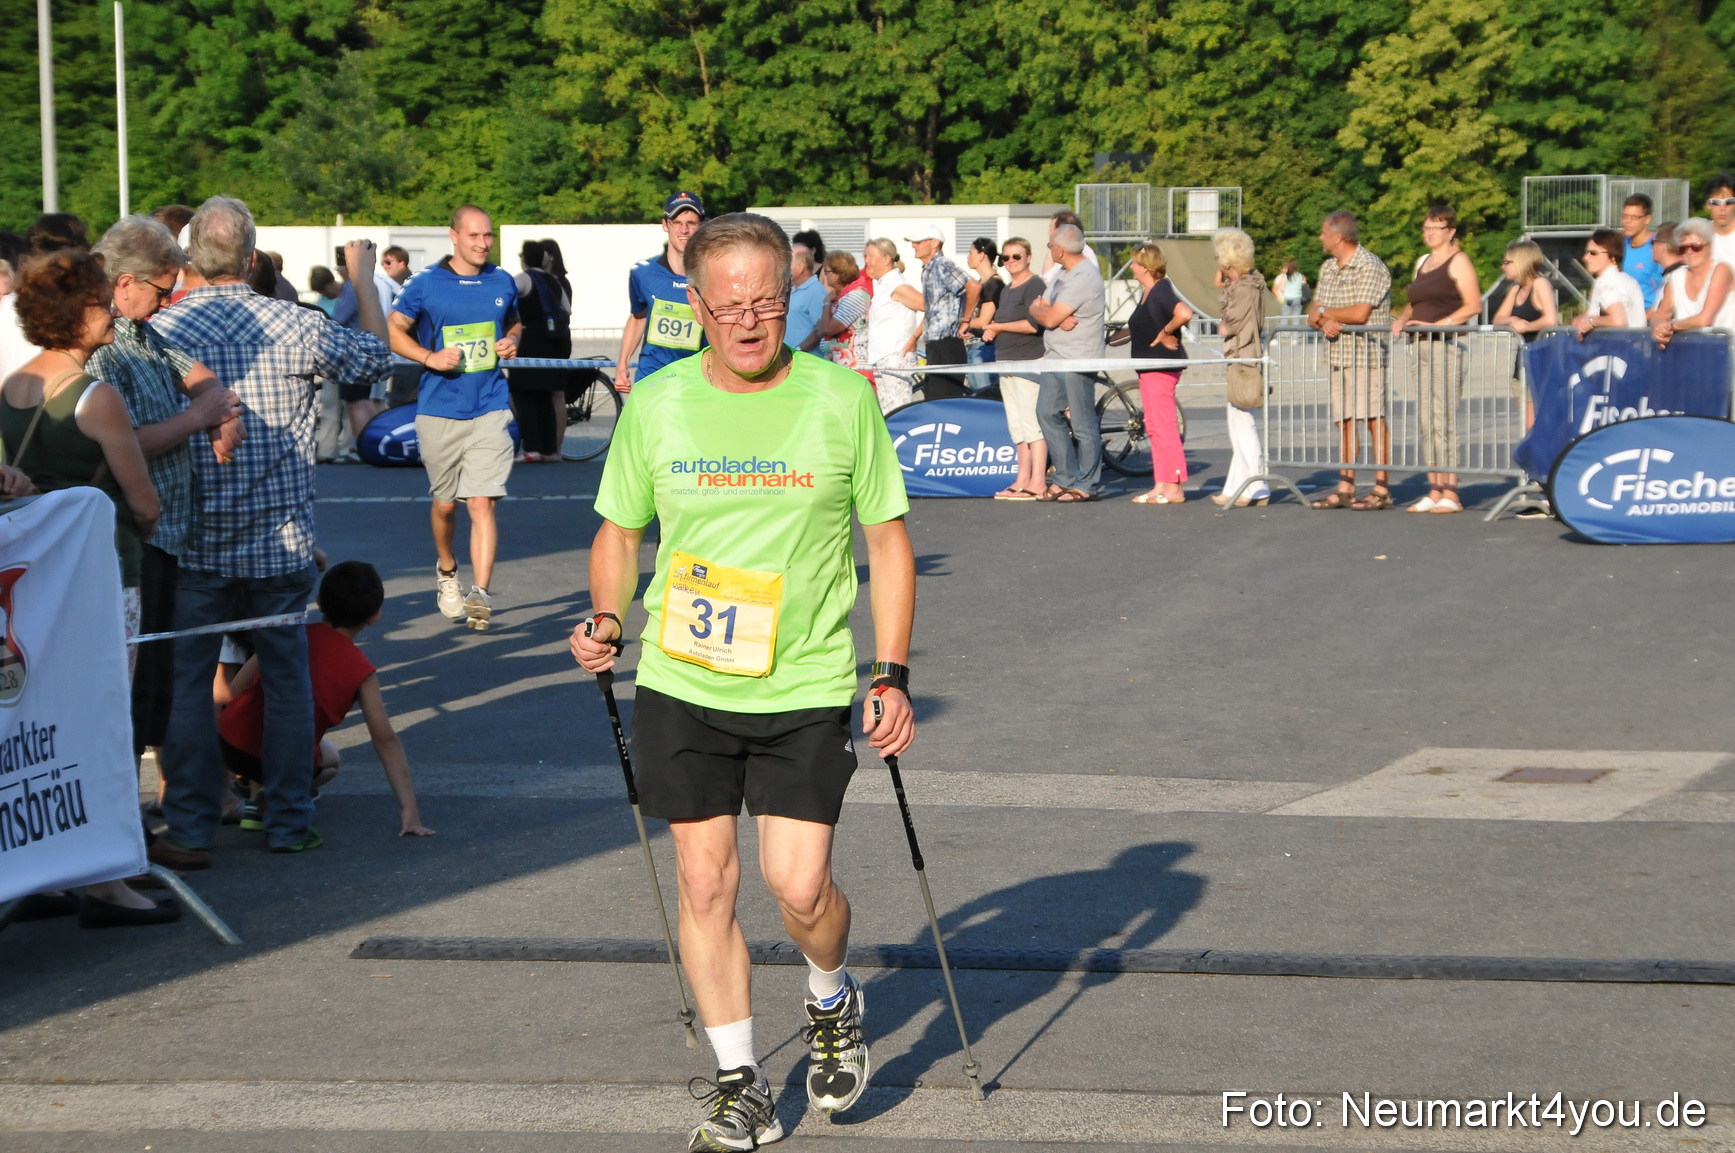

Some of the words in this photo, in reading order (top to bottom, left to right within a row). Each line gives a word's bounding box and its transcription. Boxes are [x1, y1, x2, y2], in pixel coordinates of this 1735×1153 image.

[657, 317, 693, 338] 691
[1579, 394, 1685, 435] Fisch
[914, 441, 1018, 466] Fische
[671, 456, 787, 474] autoladen
[925, 465, 1019, 477] AUTOMOBILE
[697, 470, 815, 488] neumarkt
[723, 487, 738, 496] und
[688, 598, 738, 645] 31
[688, 648, 715, 661] Autoladen
[716, 656, 736, 664] GmbH
[693, 640, 712, 652] Rainer
[712, 645, 733, 655] Ulrich
[0, 720, 57, 776] arkter
